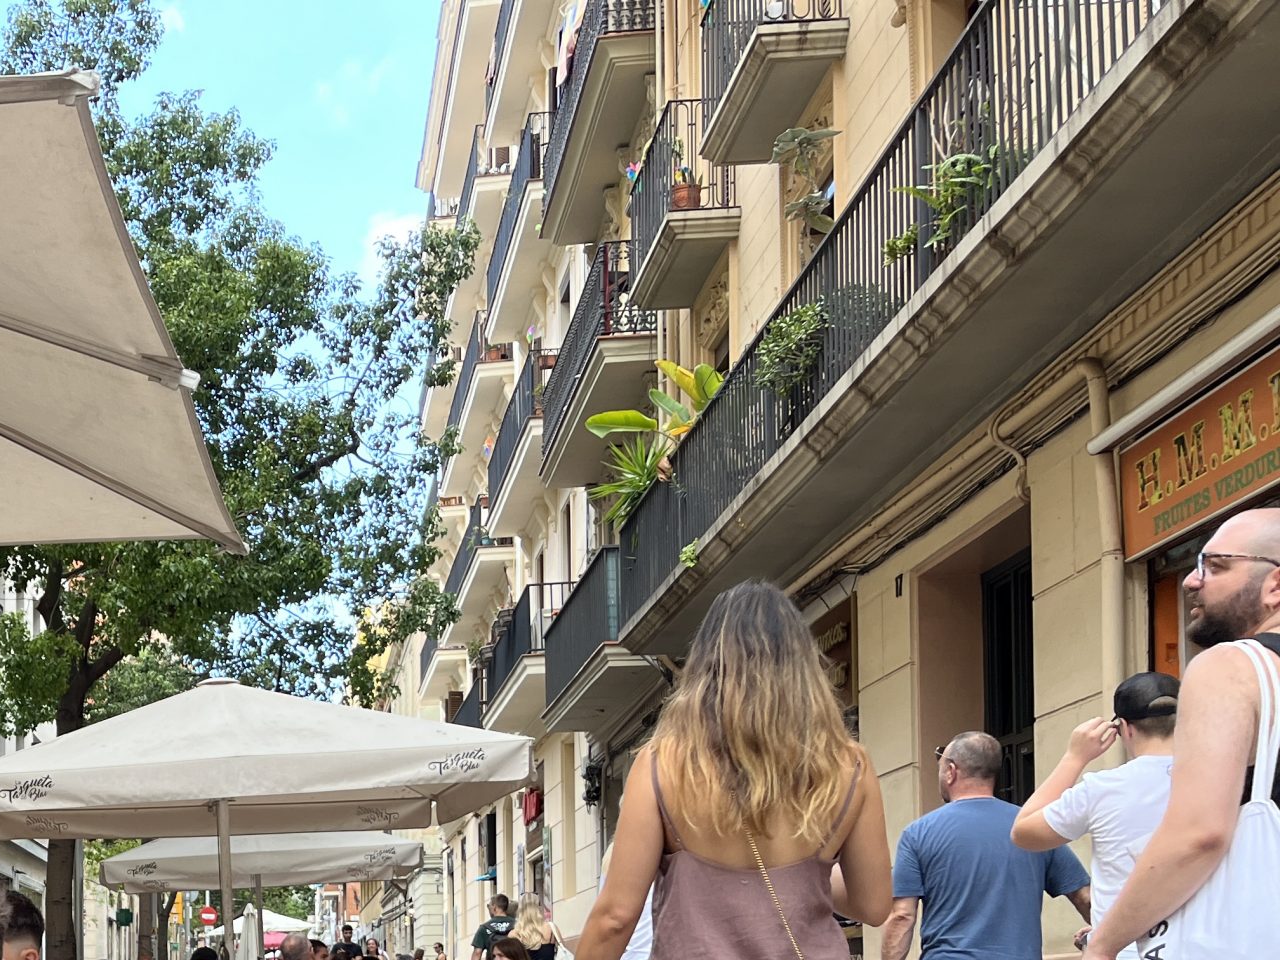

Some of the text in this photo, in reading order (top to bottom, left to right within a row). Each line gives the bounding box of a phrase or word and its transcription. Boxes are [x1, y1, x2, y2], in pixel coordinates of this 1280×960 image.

[1152, 448, 1280, 536] FRUITES VERDUR
[895, 573, 903, 598] 17
[0, 774, 53, 804] Tasqueta
